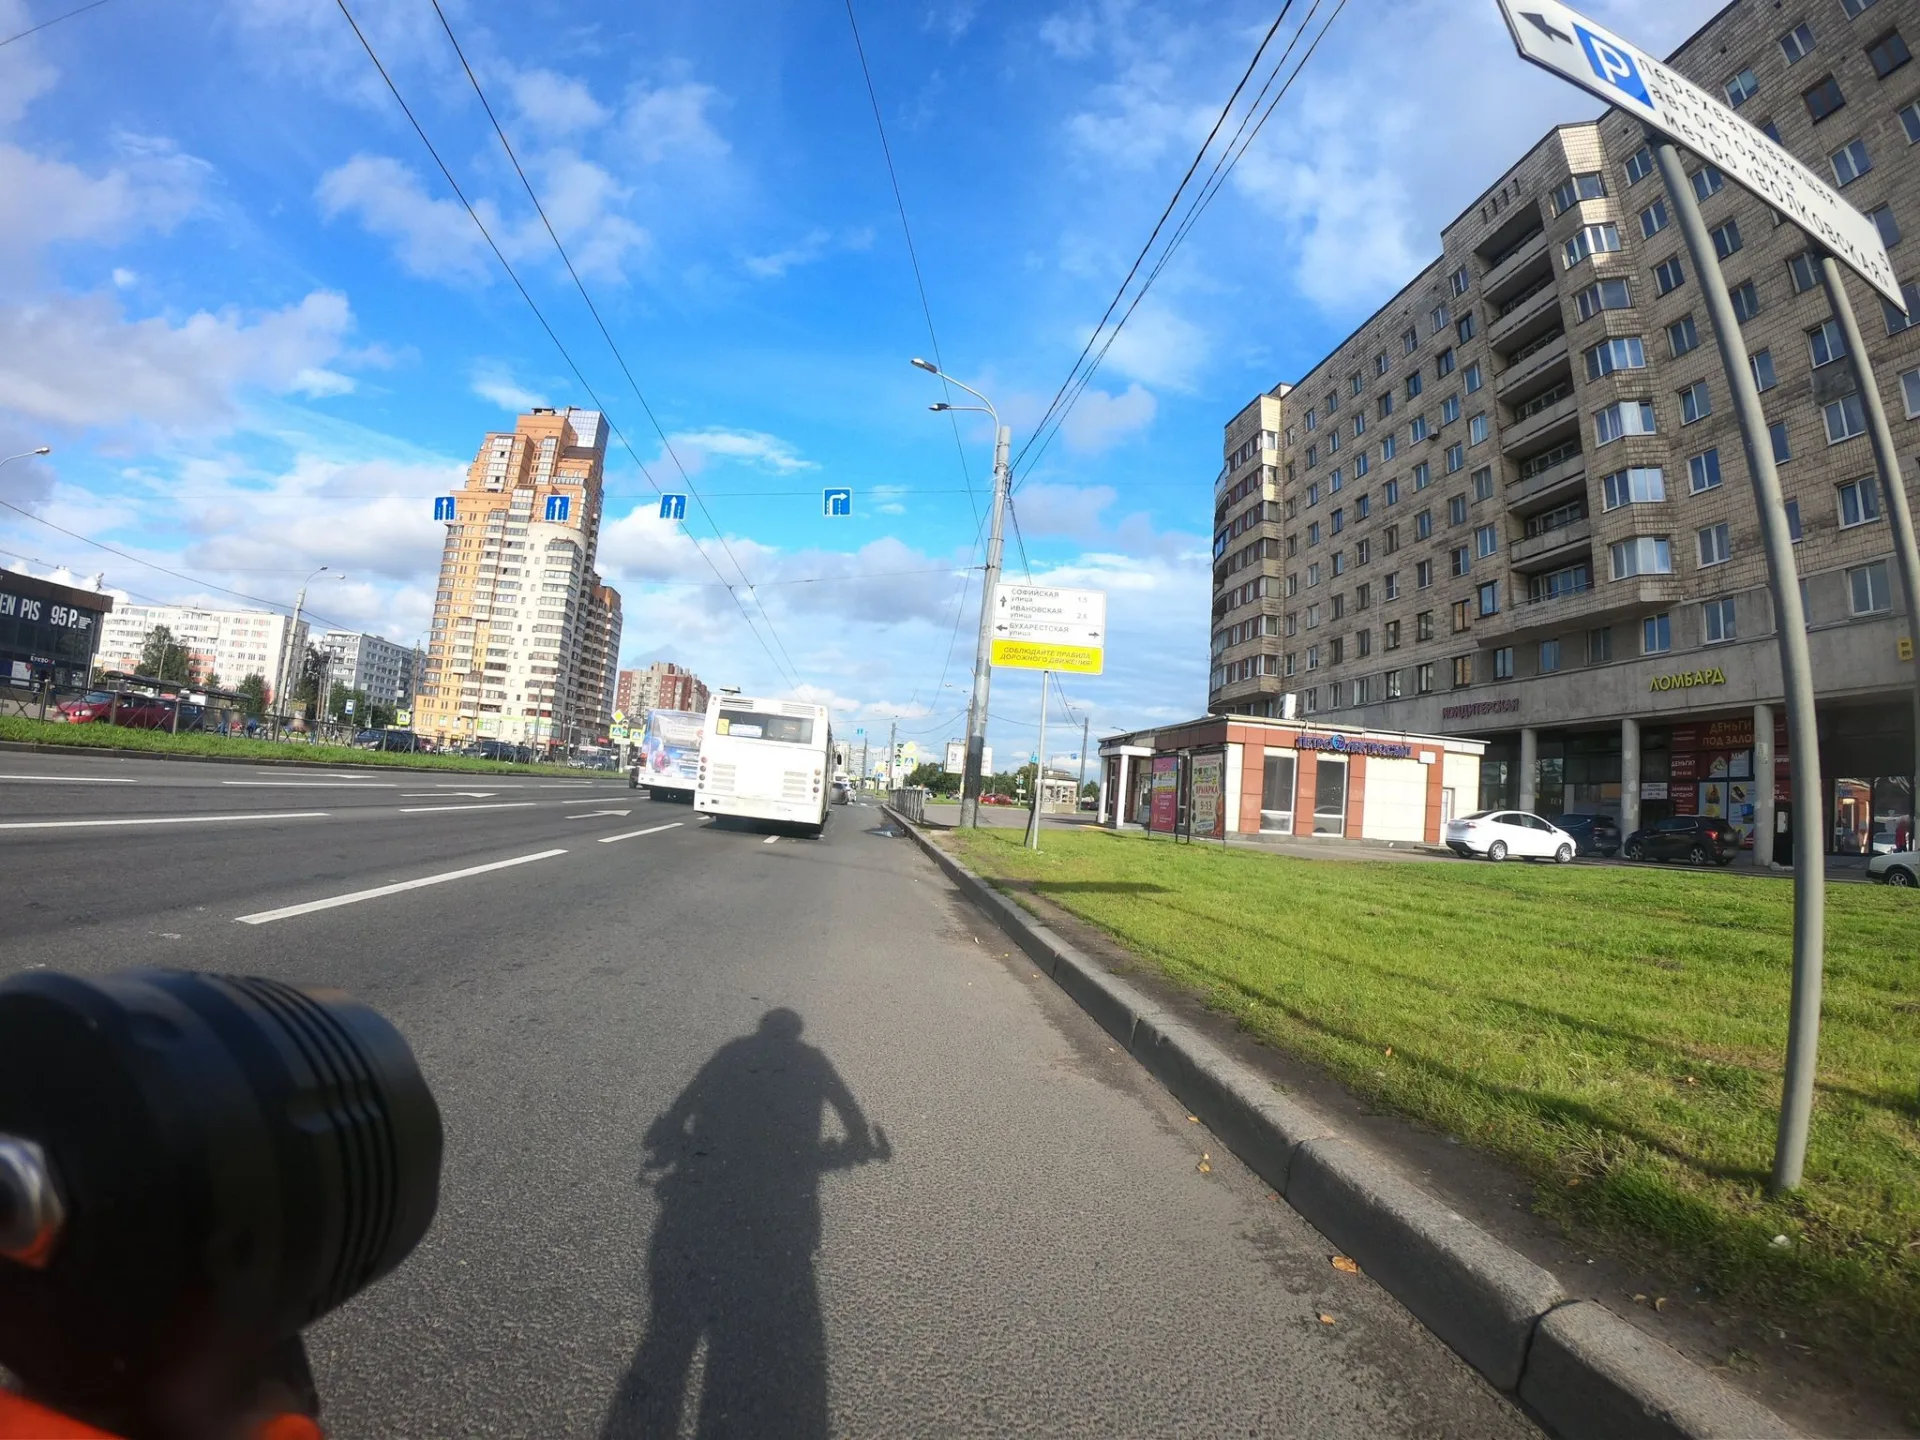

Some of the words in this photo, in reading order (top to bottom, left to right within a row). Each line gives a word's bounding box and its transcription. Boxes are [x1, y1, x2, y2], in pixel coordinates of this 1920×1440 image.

[1650, 83, 1796, 193] автостоянка
[1011, 588, 1060, 598] СОФИЙСКАЯ
[1010, 604, 1063, 615] ИВАНОВСКАЯ
[1009, 611, 1032, 620] улица
[1009, 622, 1069, 633] БУХАРЕСТСКАЯ
[1000, 653, 1049, 663] ДОРОЖНОГО
[1003, 646, 1056, 657] СОБЛЮДАЙТЕ
[1056, 650, 1091, 660] ПРАВИЛА
[1649, 666, 1726, 692] ЛОМБАРД
[1442, 698, 1520, 720] КОНДИТЕРСКАЯ
[1710, 719, 1752, 736] ДЕНЬГИ
[1702, 736, 1725, 747] ПОД
